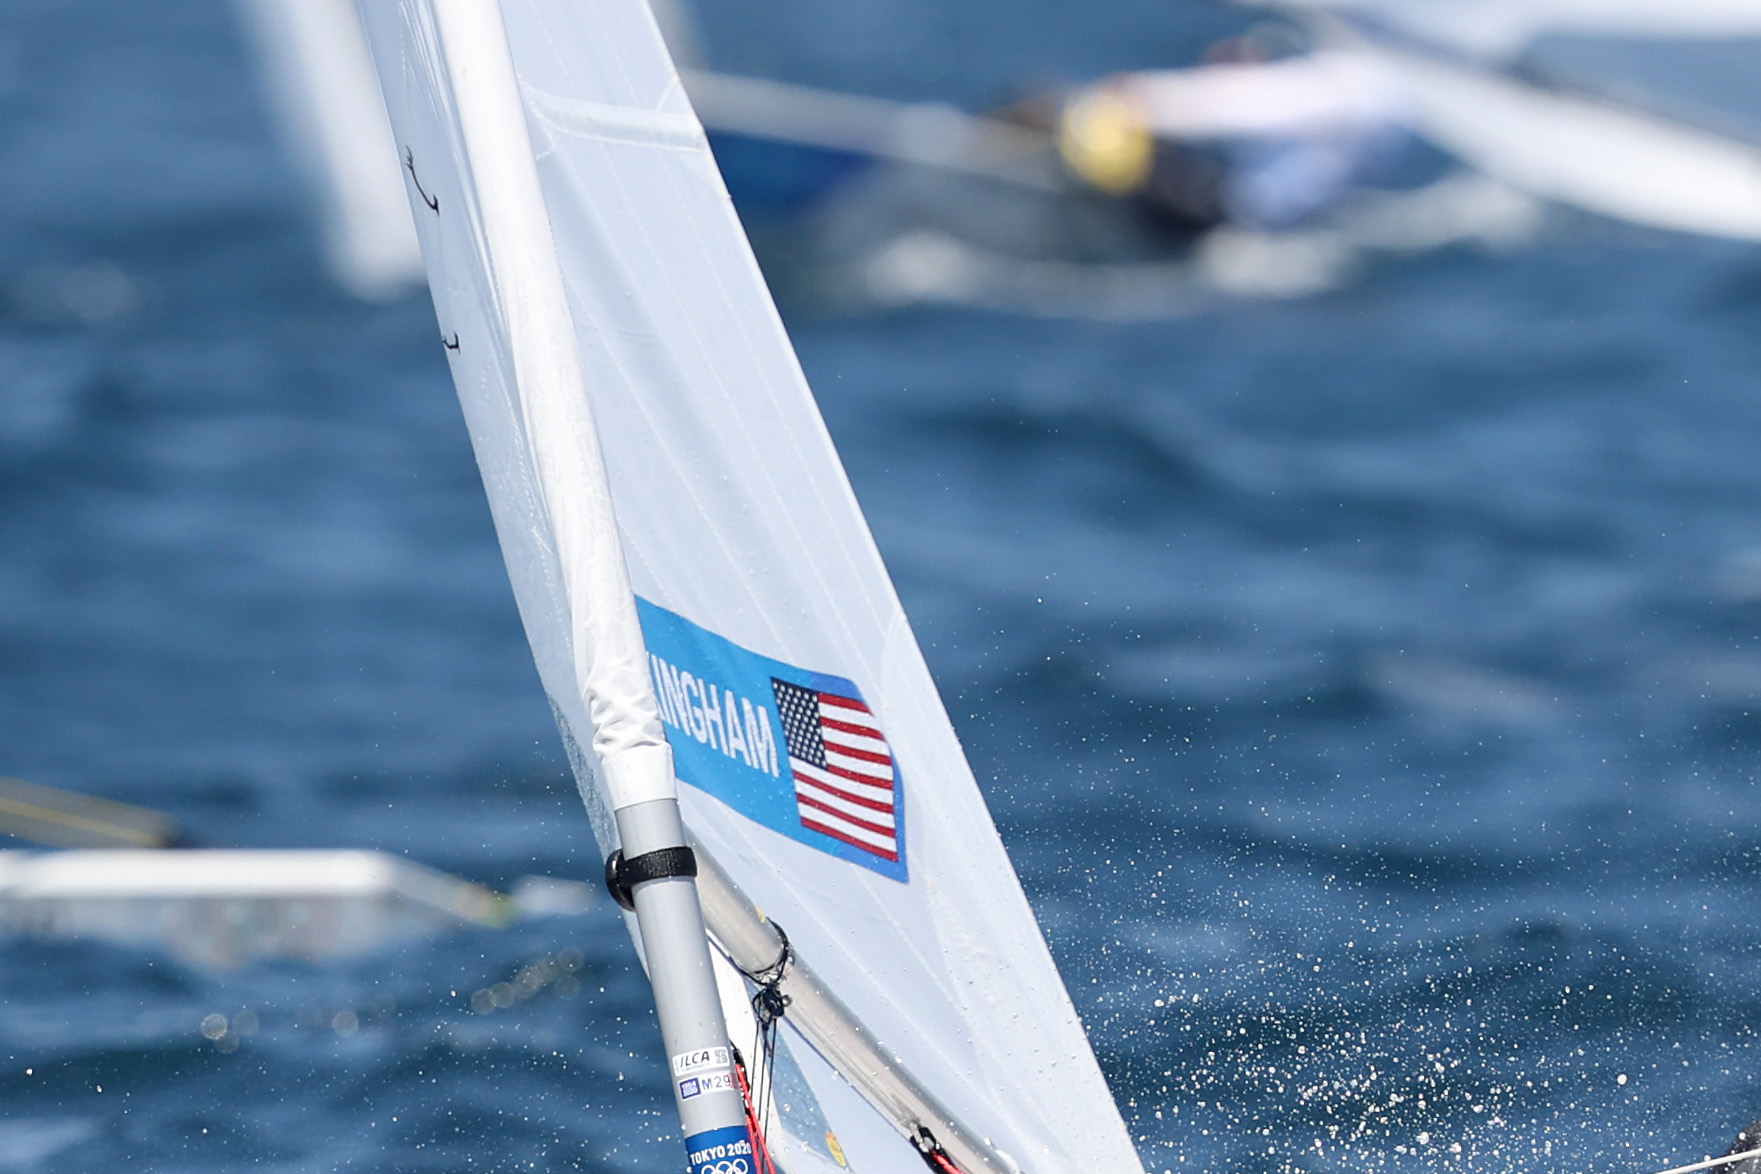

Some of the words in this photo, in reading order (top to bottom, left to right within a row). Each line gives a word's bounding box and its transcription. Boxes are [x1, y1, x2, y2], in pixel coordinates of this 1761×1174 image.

[646, 651, 780, 778] INGHAM
[680, 1051, 710, 1068] ILCA
[690, 1145, 726, 1166] TOKYO
